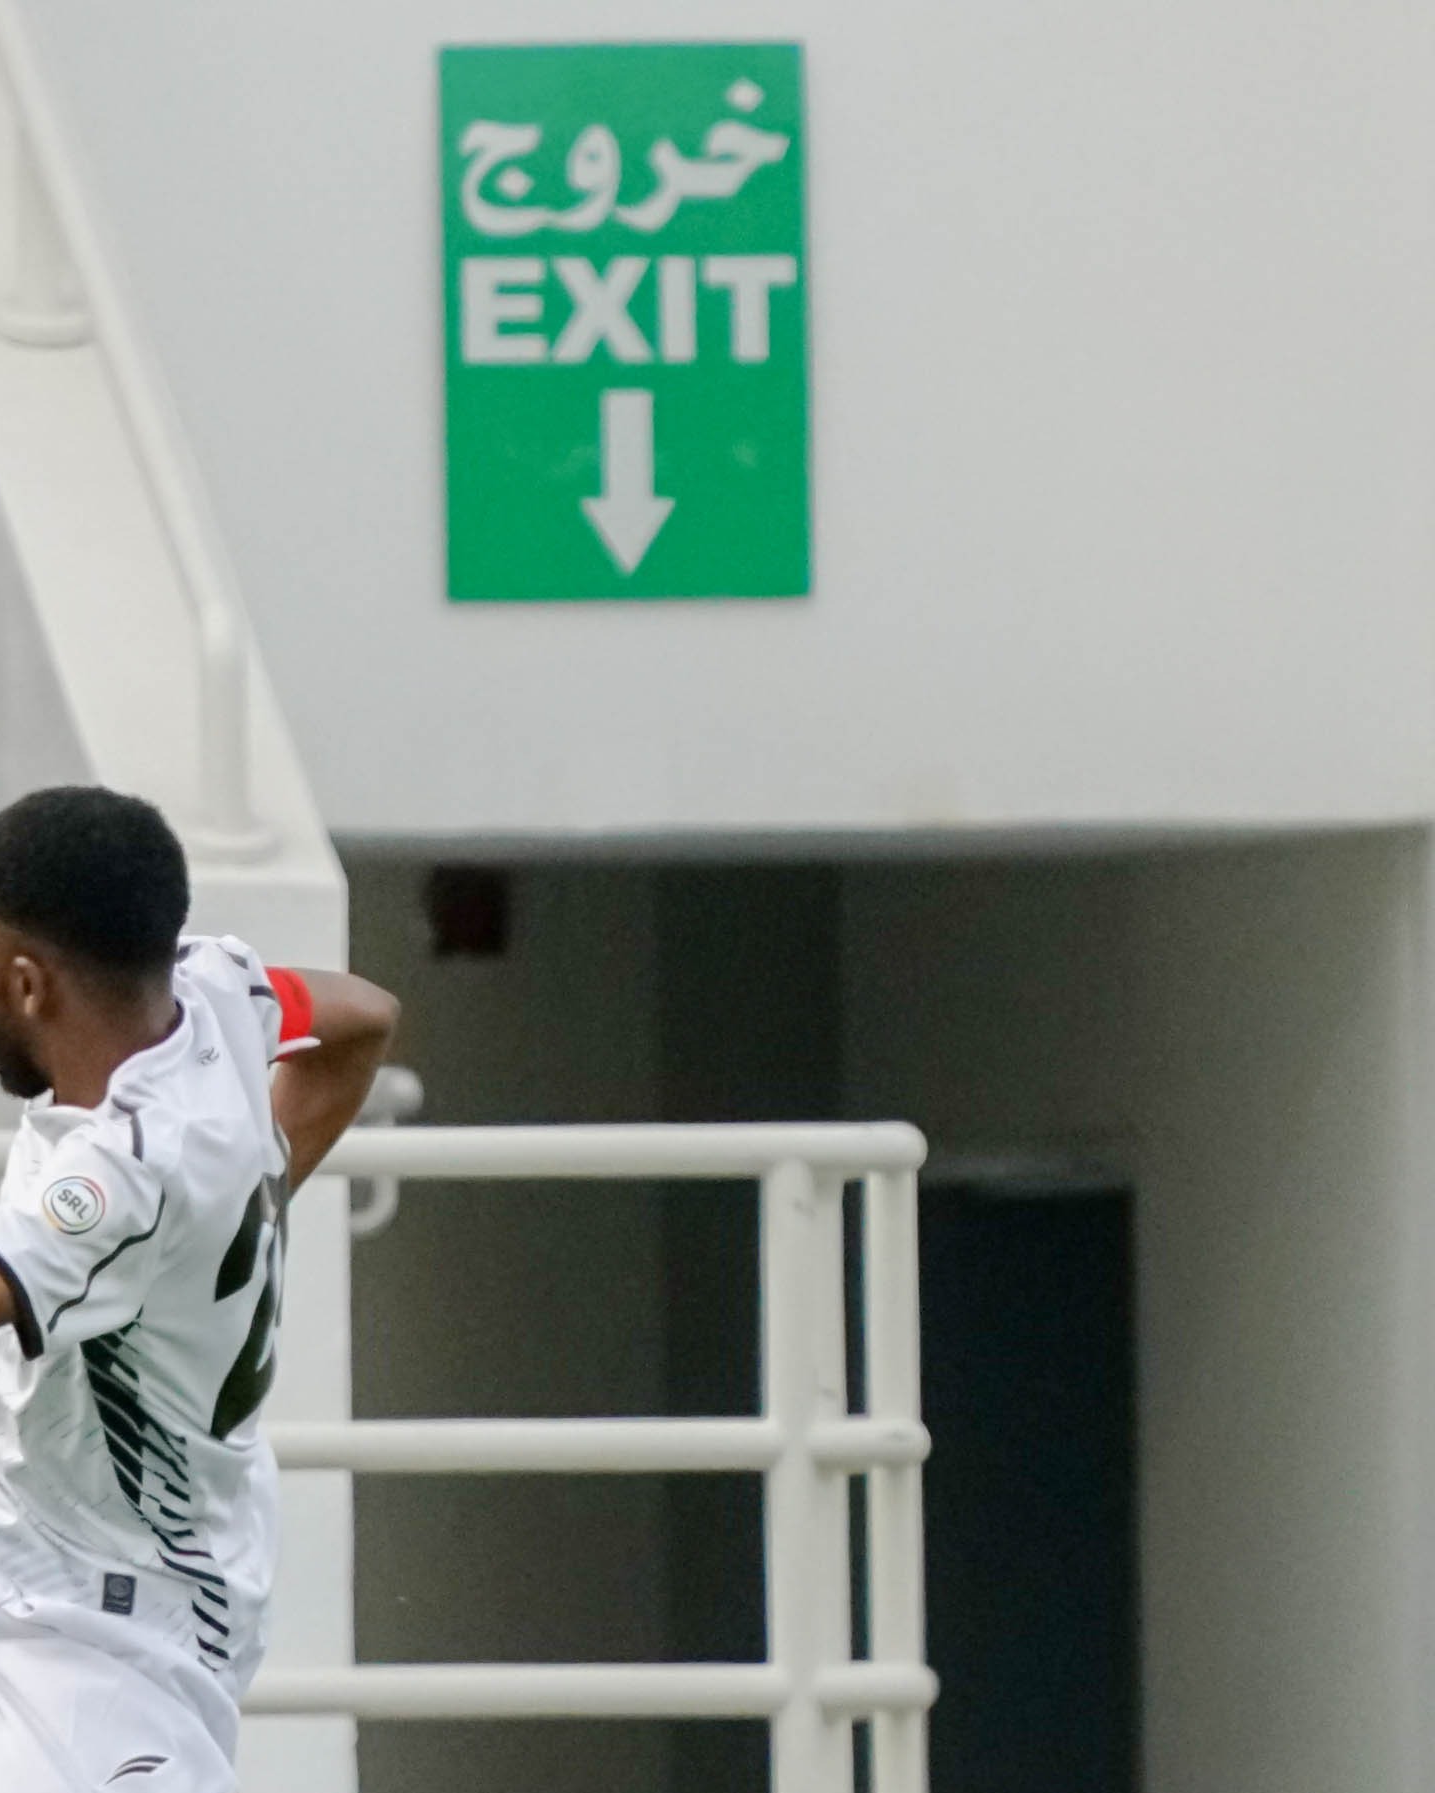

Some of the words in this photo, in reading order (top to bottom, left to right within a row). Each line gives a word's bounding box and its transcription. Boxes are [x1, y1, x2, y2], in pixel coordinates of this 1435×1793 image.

[458, 78, 790, 236] خروج
[460, 255, 798, 364] EXIT
[57, 1188, 90, 1220] SRL
